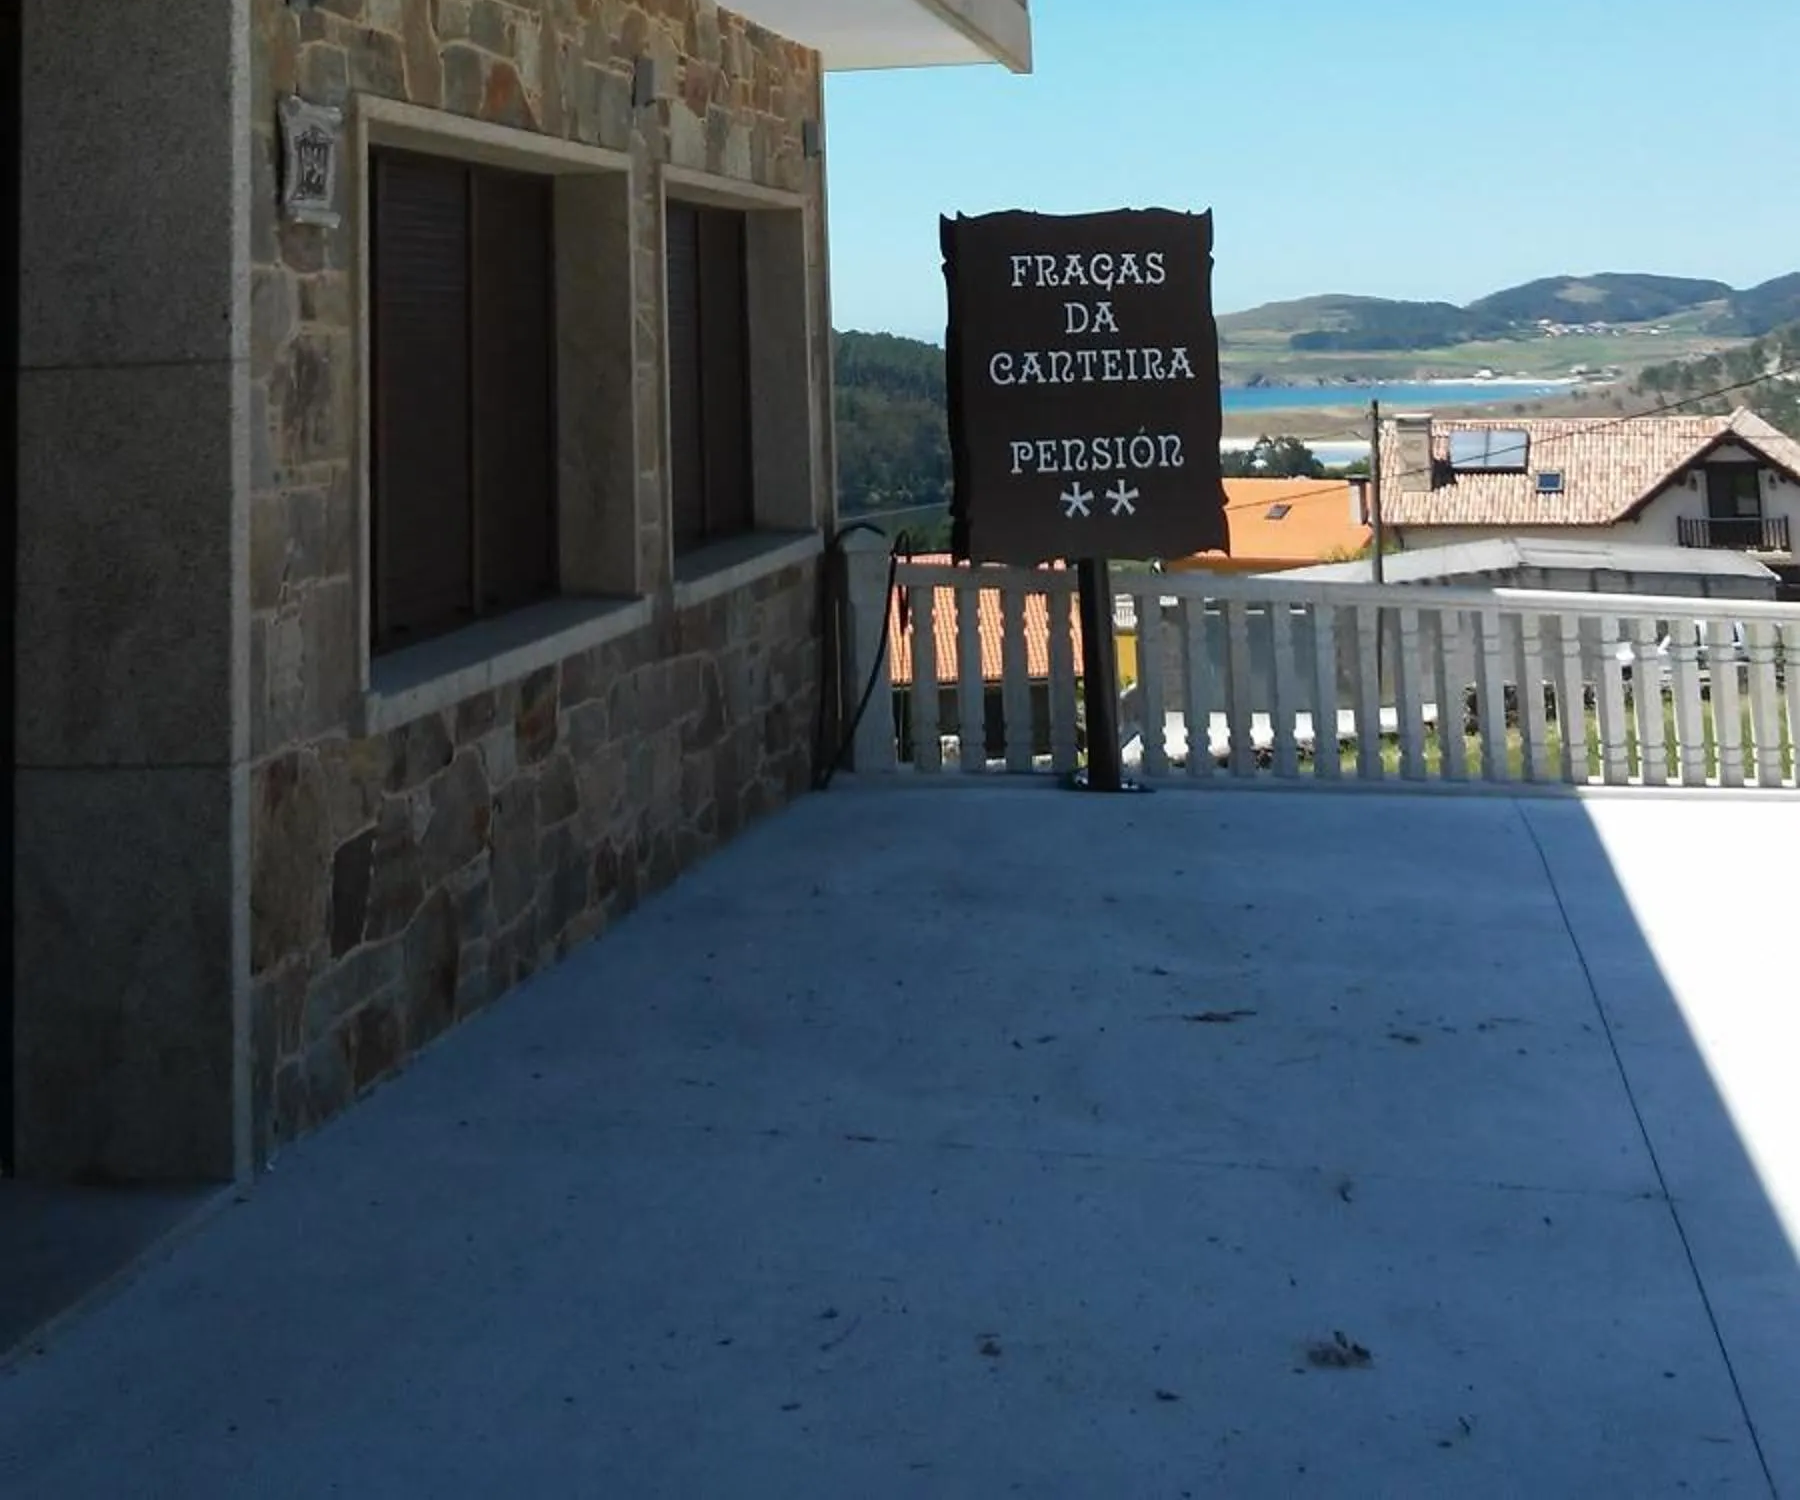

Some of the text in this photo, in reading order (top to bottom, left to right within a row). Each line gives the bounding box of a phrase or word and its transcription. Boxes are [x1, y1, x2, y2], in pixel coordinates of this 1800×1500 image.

[1010, 252, 1166, 291] FRAGAS
[1063, 301, 1119, 334] DA
[989, 347, 1196, 385] CANTEIRA
[1009, 427, 1185, 475] PENSIÓN
